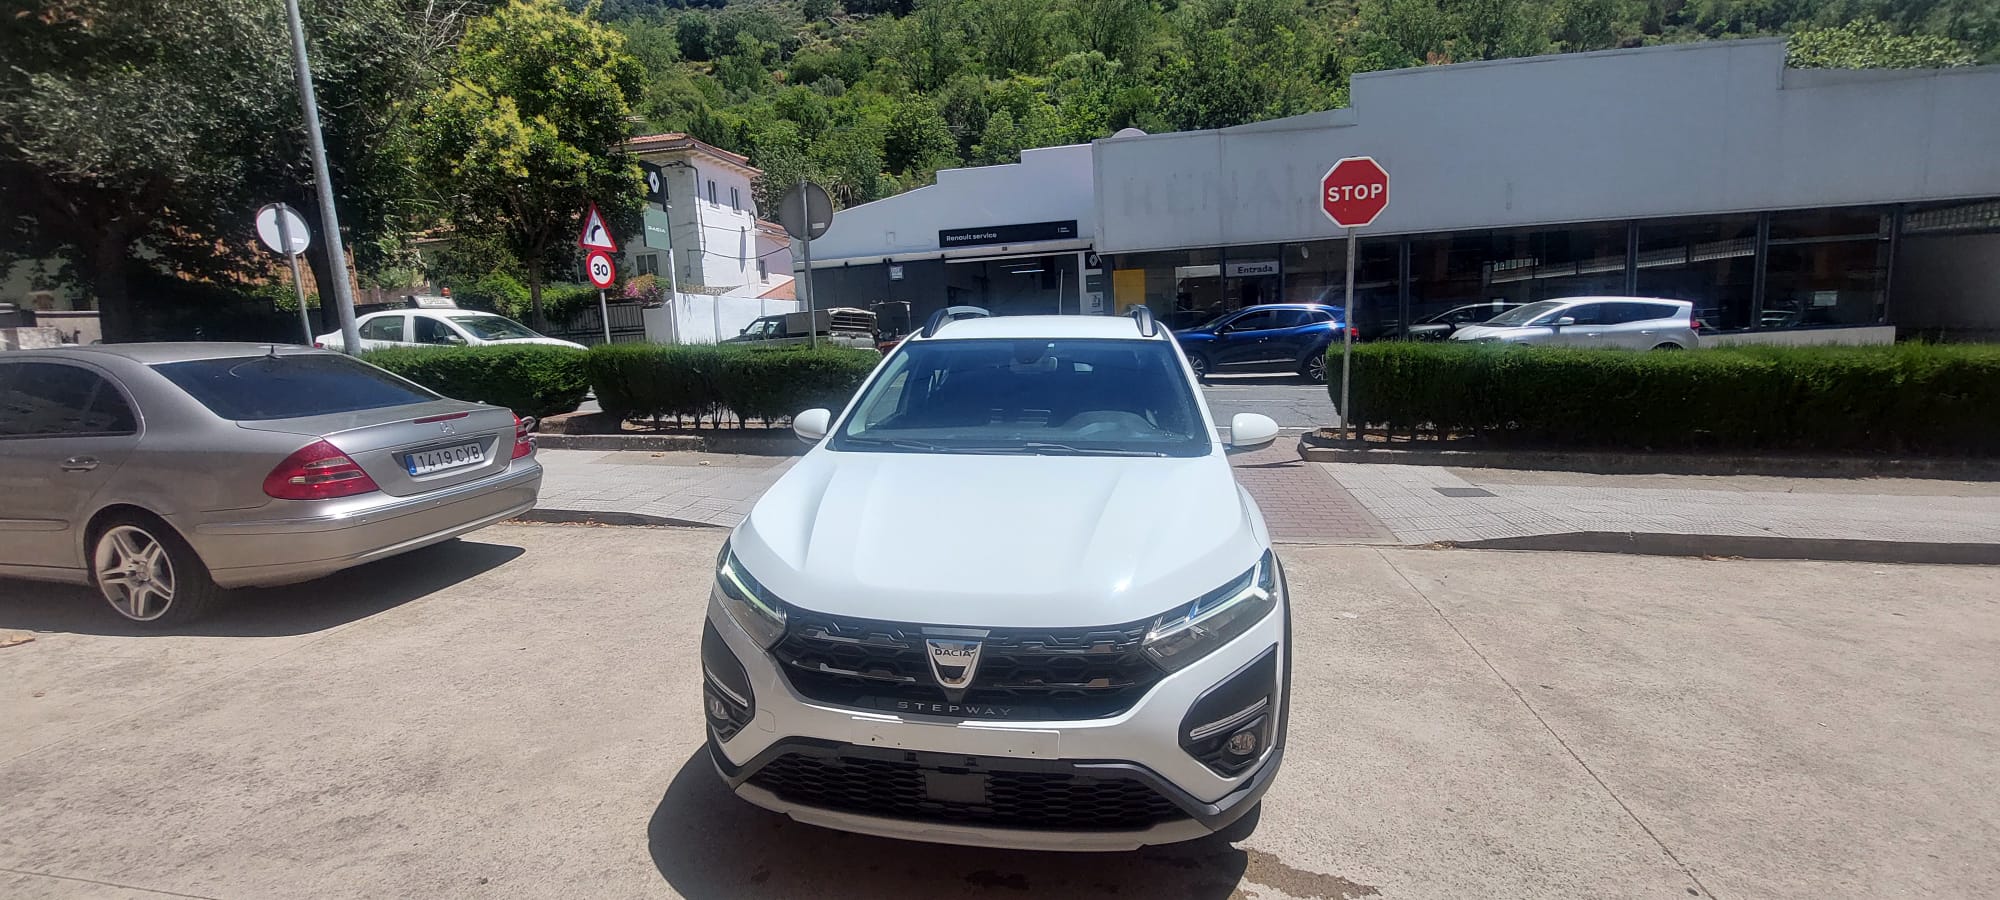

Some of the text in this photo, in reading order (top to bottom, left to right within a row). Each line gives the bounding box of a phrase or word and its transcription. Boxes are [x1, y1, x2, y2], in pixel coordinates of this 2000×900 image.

[1327, 183, 1383, 202] STOP
[946, 232, 997, 242] Renault service
[593, 263, 608, 276] 30
[1237, 264, 1273, 274] Entrada
[418, 446, 480, 469] 1419 CYB
[934, 648, 972, 657] DACIA
[897, 701, 1011, 716] STEPWAY
